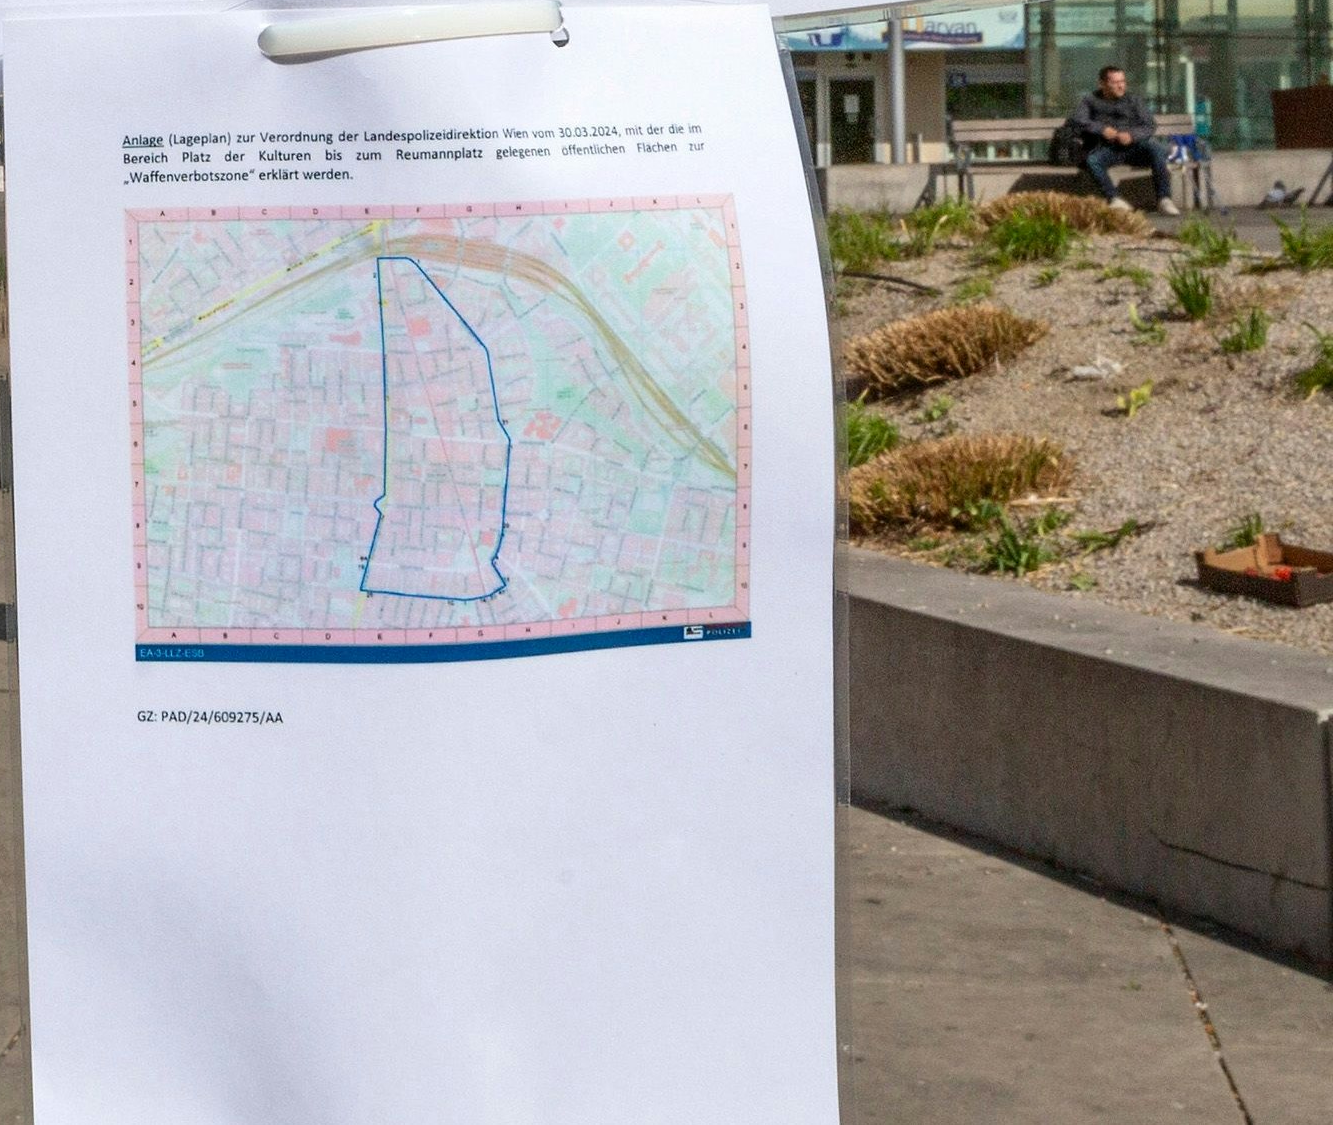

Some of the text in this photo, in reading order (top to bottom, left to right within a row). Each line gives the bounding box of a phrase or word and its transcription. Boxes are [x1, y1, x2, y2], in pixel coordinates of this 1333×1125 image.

[121, 133, 165, 149] Anlage
[168, 131, 231, 147] (Lageplan)
[236, 133, 256, 144] zur
[259, 130, 334, 145] Verordnung
[337, 130, 359, 142] der
[363, 127, 499, 144] Landespolizeidirektion
[502, 128, 529, 139] Wien
[531, 129, 555, 139] vom
[558, 125, 622, 139] 30.03.2024,
[625, 126, 643, 135] mit
[646, 125, 663, 135] der
[668, 124, 684, 134] die
[122, 151, 169, 165] Bereich
[181, 150, 211, 163] Platz
[223, 149, 246, 163] der
[258, 149, 312, 162] Kulturen
[324, 148, 343, 161] bis
[355, 151, 382, 161] zum
[395, 146, 483, 161] Reumannplatz
[495, 145, 551, 160] gelegenen
[688, 142, 704, 151] zur
[257, 168, 299, 181] erklärt
[301, 167, 353, 180] werden.
[136, 709, 284, 725] GZ: PAD/24/609275/AA
